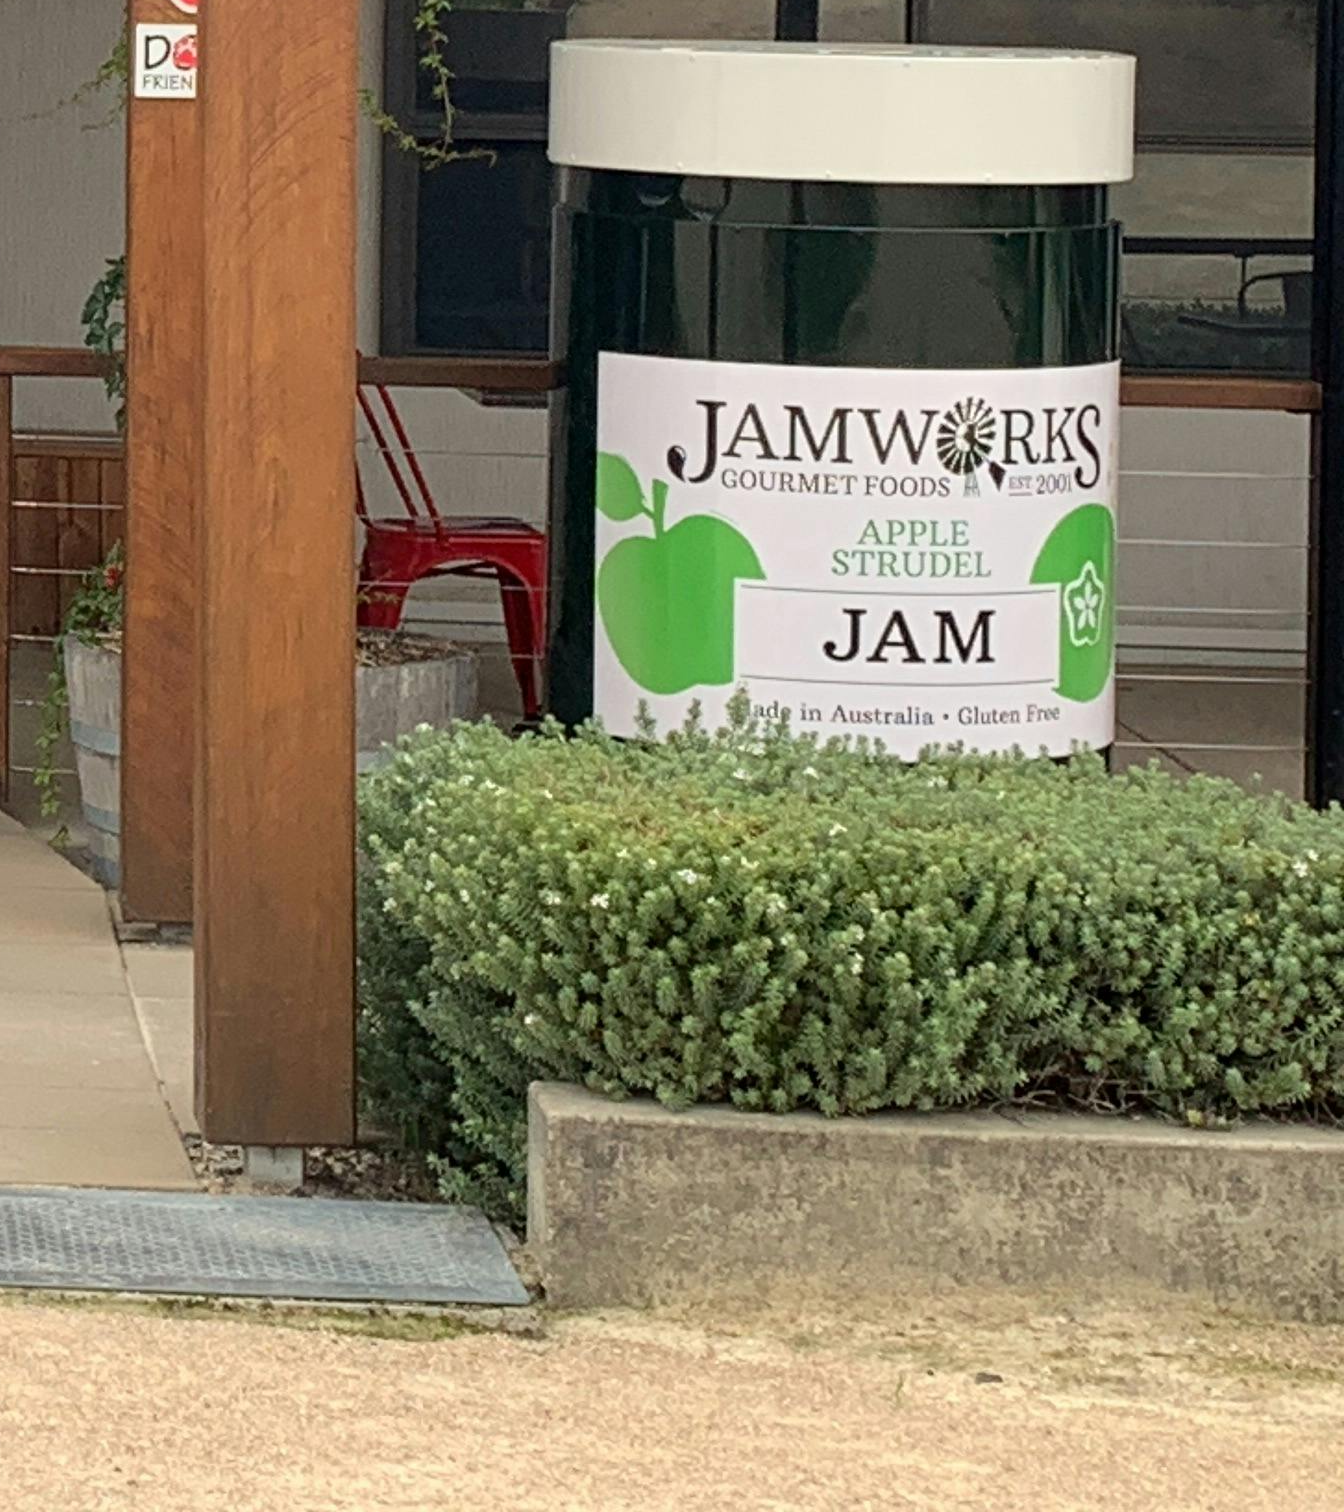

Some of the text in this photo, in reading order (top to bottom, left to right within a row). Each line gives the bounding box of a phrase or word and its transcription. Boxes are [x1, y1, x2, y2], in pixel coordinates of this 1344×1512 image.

[144, 34, 198, 71] DO
[142, 74, 193, 90] FRIEN
[721, 469, 858, 495] GOURMET
[863, 474, 951, 497] FOODS
[1036, 472, 1072, 495] 2001
[857, 519, 970, 547] APPLE
[831, 550, 992, 579] STRUDEL
[823, 608, 996, 664] JAM
[800, 702, 822, 721] in
[830, 704, 934, 726] Australia
[958, 706, 1021, 725] Gluten
[1026, 704, 1061, 723] Free
